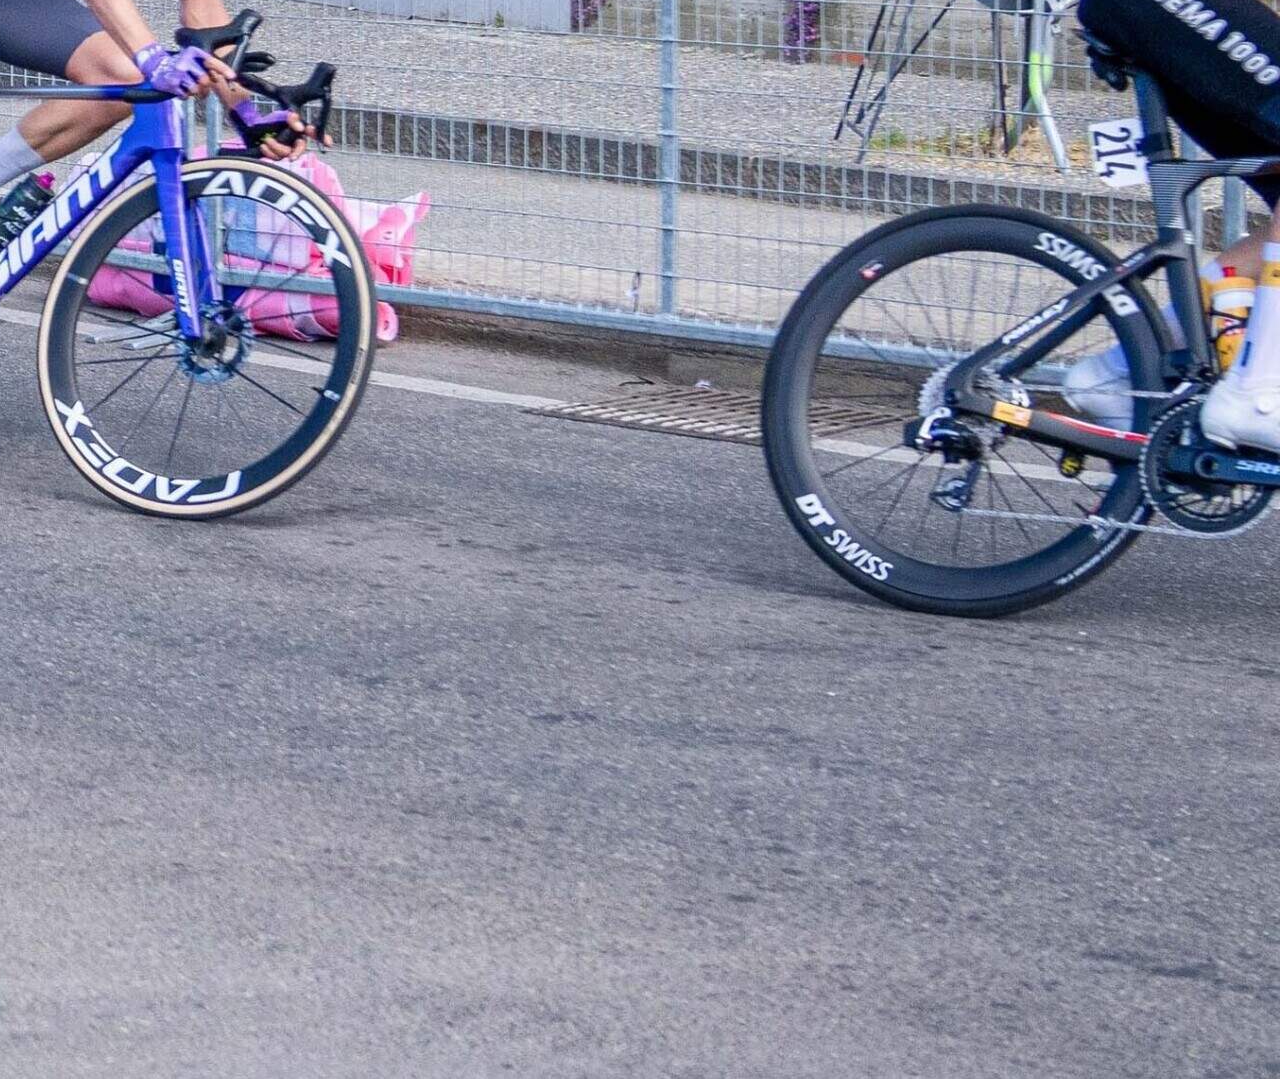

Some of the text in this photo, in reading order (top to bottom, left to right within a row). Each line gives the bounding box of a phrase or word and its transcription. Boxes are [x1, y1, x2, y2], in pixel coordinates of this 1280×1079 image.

[1216, 32, 1280, 86] 1000
[1092, 124, 1138, 180] 214
[1034, 231, 1108, 281] SWISS
[53, 398, 242, 504] CADEX
[794, 492, 894, 582] DT SWISS
